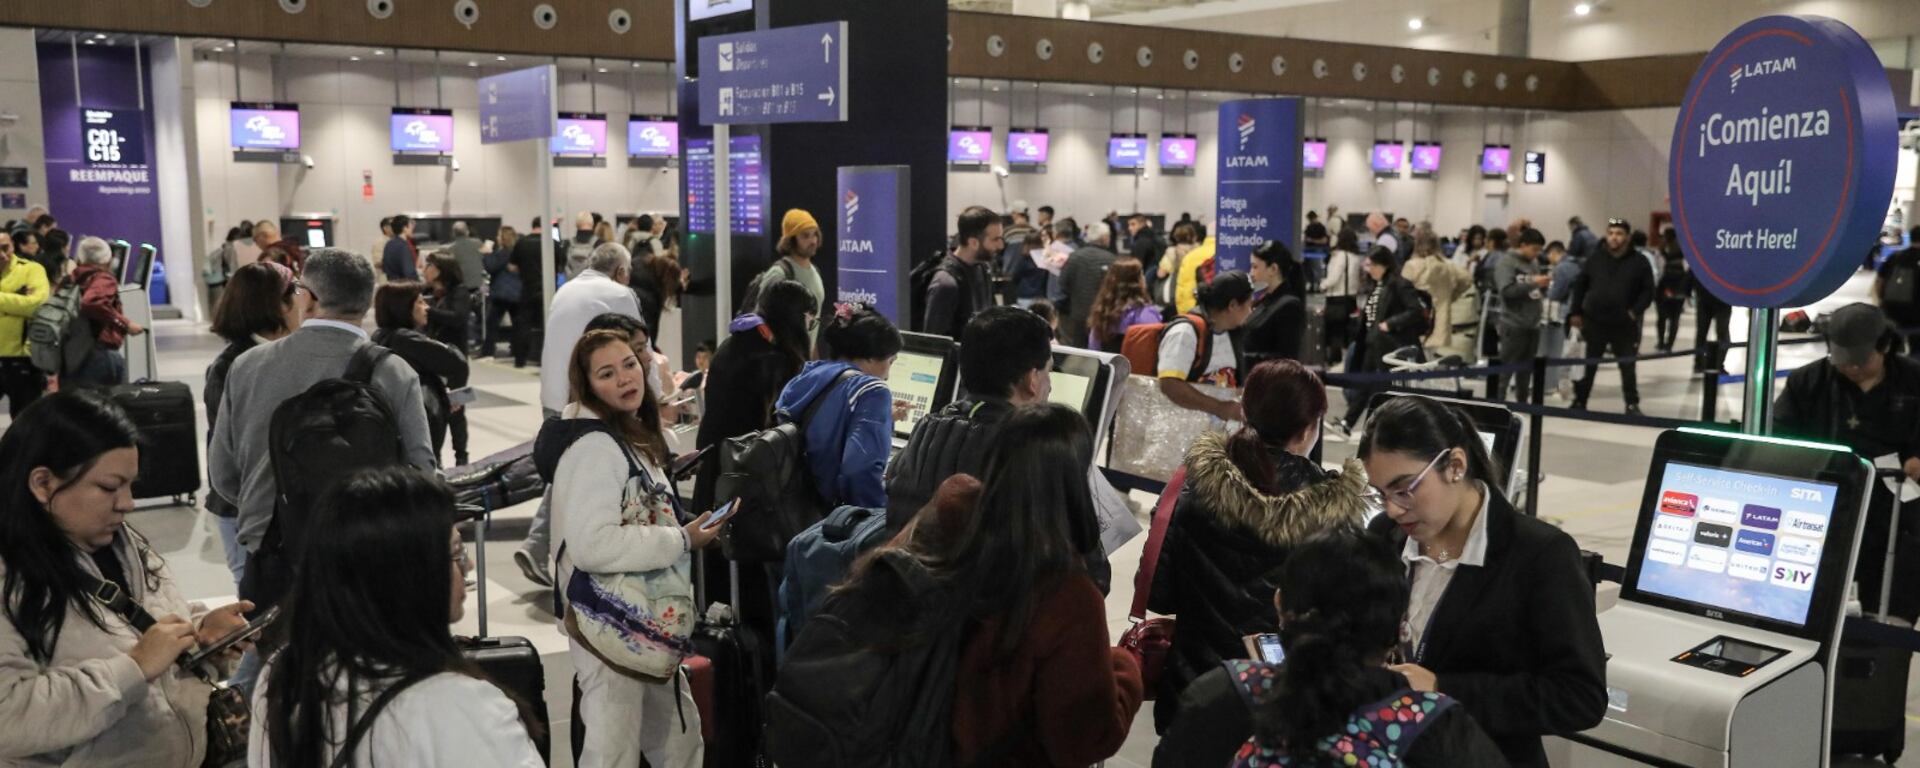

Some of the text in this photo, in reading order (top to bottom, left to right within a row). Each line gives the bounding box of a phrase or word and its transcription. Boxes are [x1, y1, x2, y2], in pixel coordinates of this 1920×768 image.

[1745, 57, 1797, 77] LATAM
[791, 82, 804, 97] B15
[1699, 106, 1830, 158] ¡Comienza
[88, 144, 121, 161] C15
[1225, 155, 1269, 168] LATAM
[70, 168, 149, 184] REEMPAQUE
[1725, 159, 1793, 206] Aquí!
[1220, 196, 1248, 213] Entrega
[1228, 213, 1268, 231] Equipaje
[1219, 232, 1264, 249] Etiquetado
[1716, 227, 1799, 249] Start Here!
[1734, 479, 1778, 497] Check-in
[1790, 487, 1823, 502] SITA
[1752, 514, 1778, 523] LATAM
